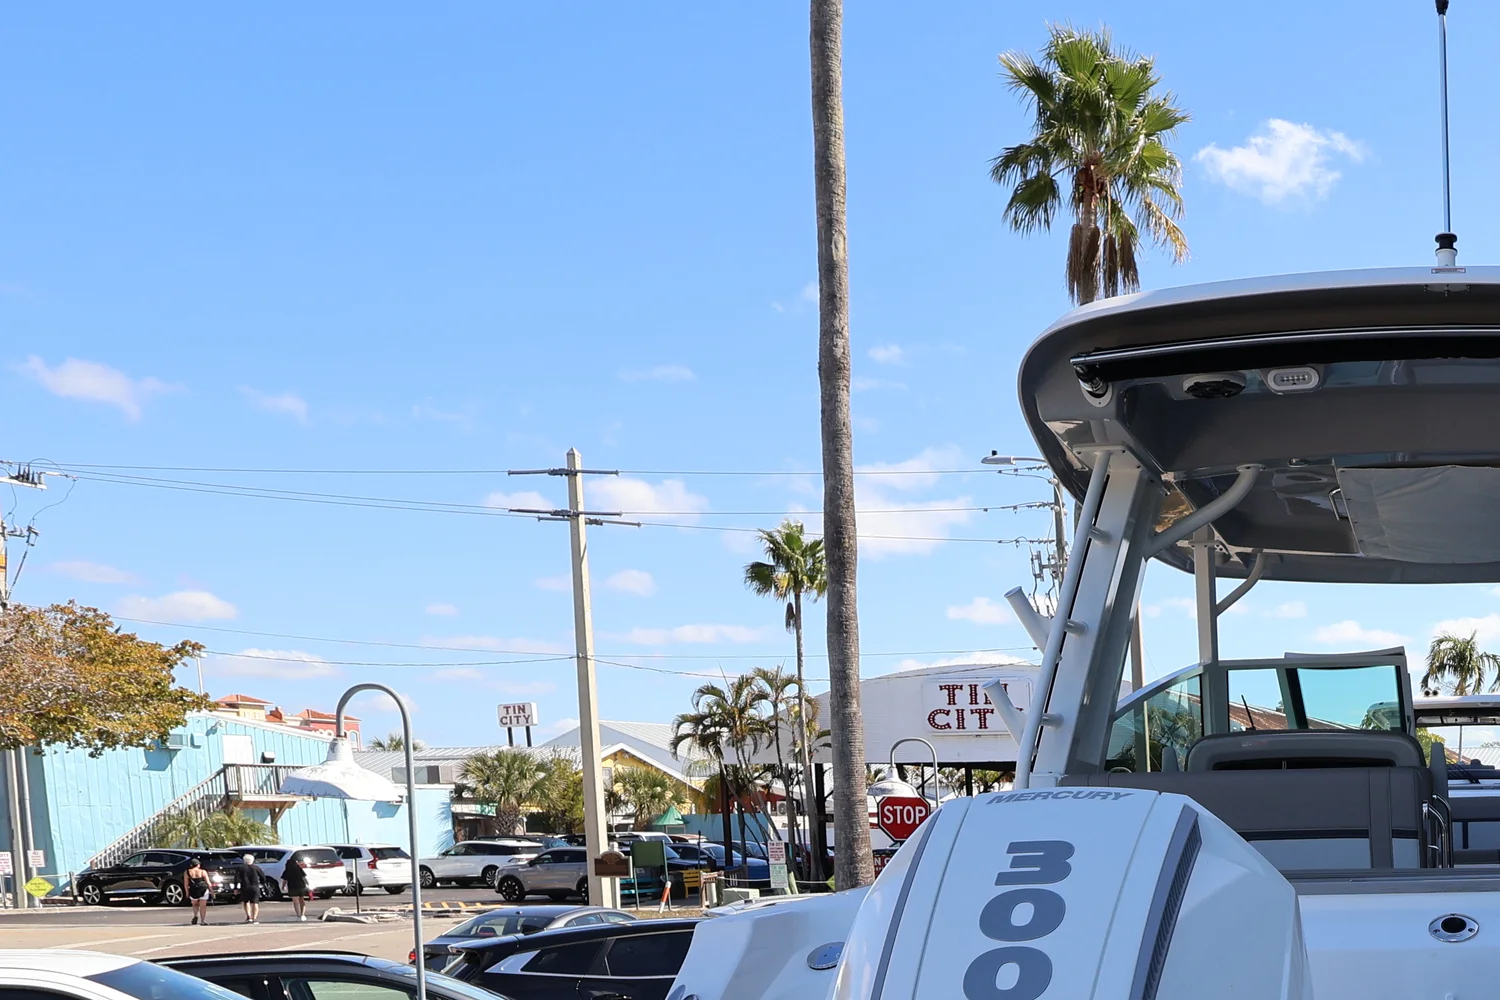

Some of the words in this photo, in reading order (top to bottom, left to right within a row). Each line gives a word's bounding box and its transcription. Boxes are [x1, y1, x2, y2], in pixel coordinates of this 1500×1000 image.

[503, 704, 526, 715] TIN
[500, 714, 531, 726] CITY
[927, 707, 1023, 730] CIT
[985, 790, 1135, 805] MERCURY
[883, 805, 926, 825] STOP
